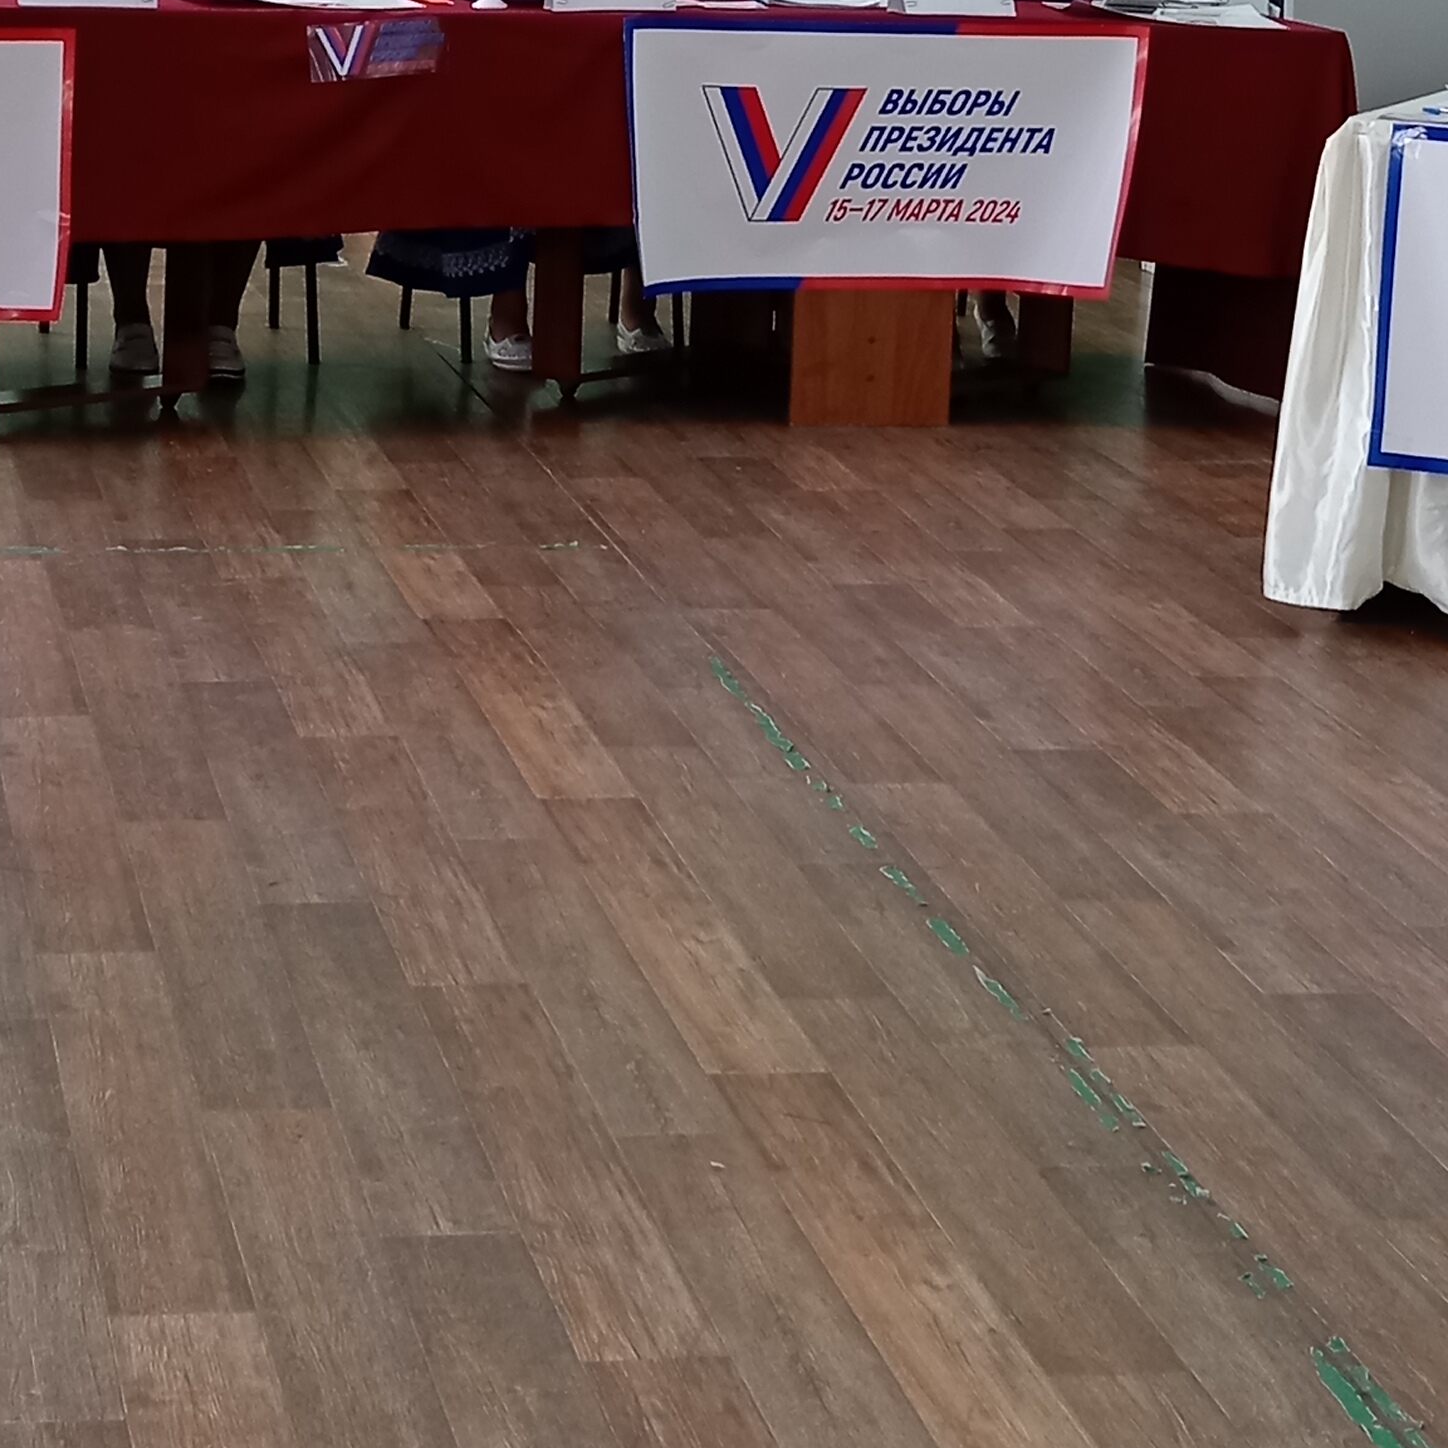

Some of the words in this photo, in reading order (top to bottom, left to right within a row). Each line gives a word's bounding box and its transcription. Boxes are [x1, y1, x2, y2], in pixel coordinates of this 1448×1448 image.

[878, 88, 1021, 117] ВЫБОРЫ
[858, 125, 1056, 157] ПРЕЗИДЕНТА
[839, 162, 969, 190] РОССИИ
[886, 198, 965, 223] МАРТА
[964, 199, 1022, 224] 2024
